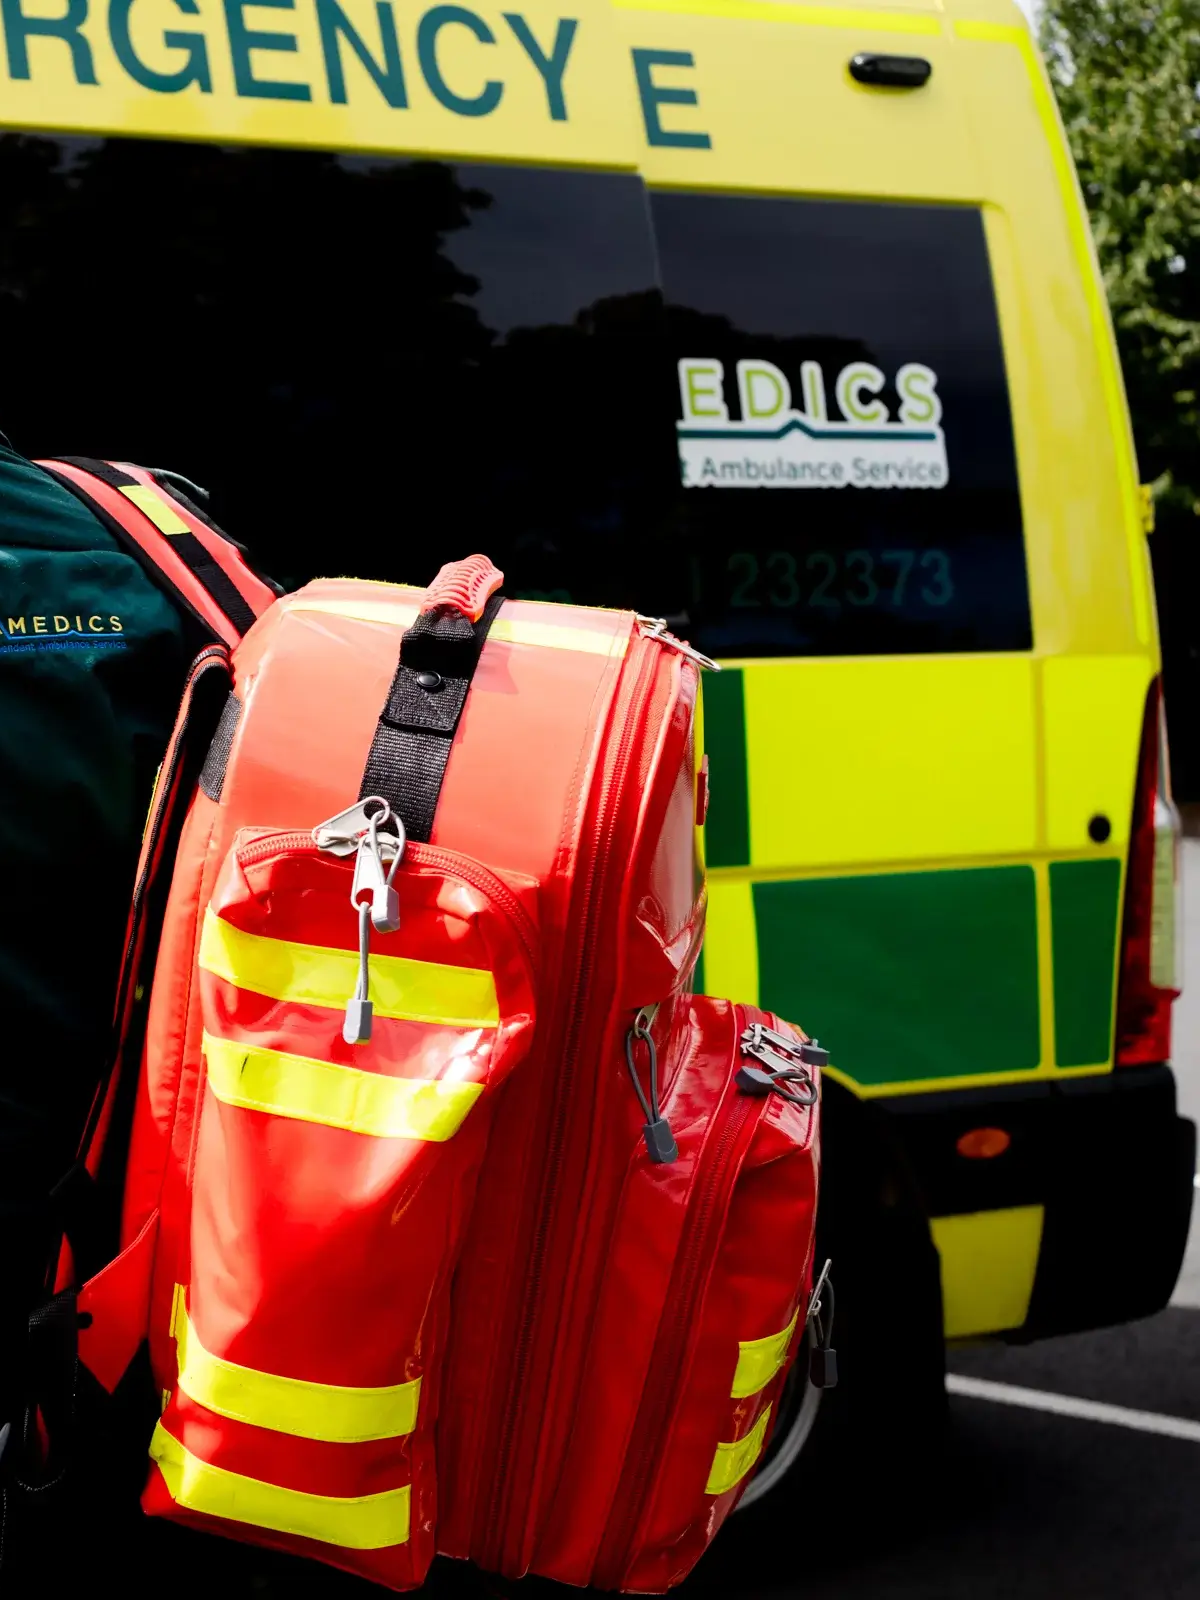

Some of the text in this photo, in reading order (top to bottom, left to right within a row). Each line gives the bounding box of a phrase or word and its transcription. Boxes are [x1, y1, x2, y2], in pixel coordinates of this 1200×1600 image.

[630, 47, 712, 150] E
[685, 366, 937, 422] EDICS
[702, 456, 843, 481] Ambulance
[852, 458, 942, 482] Service
[727, 549, 955, 608] 232373
